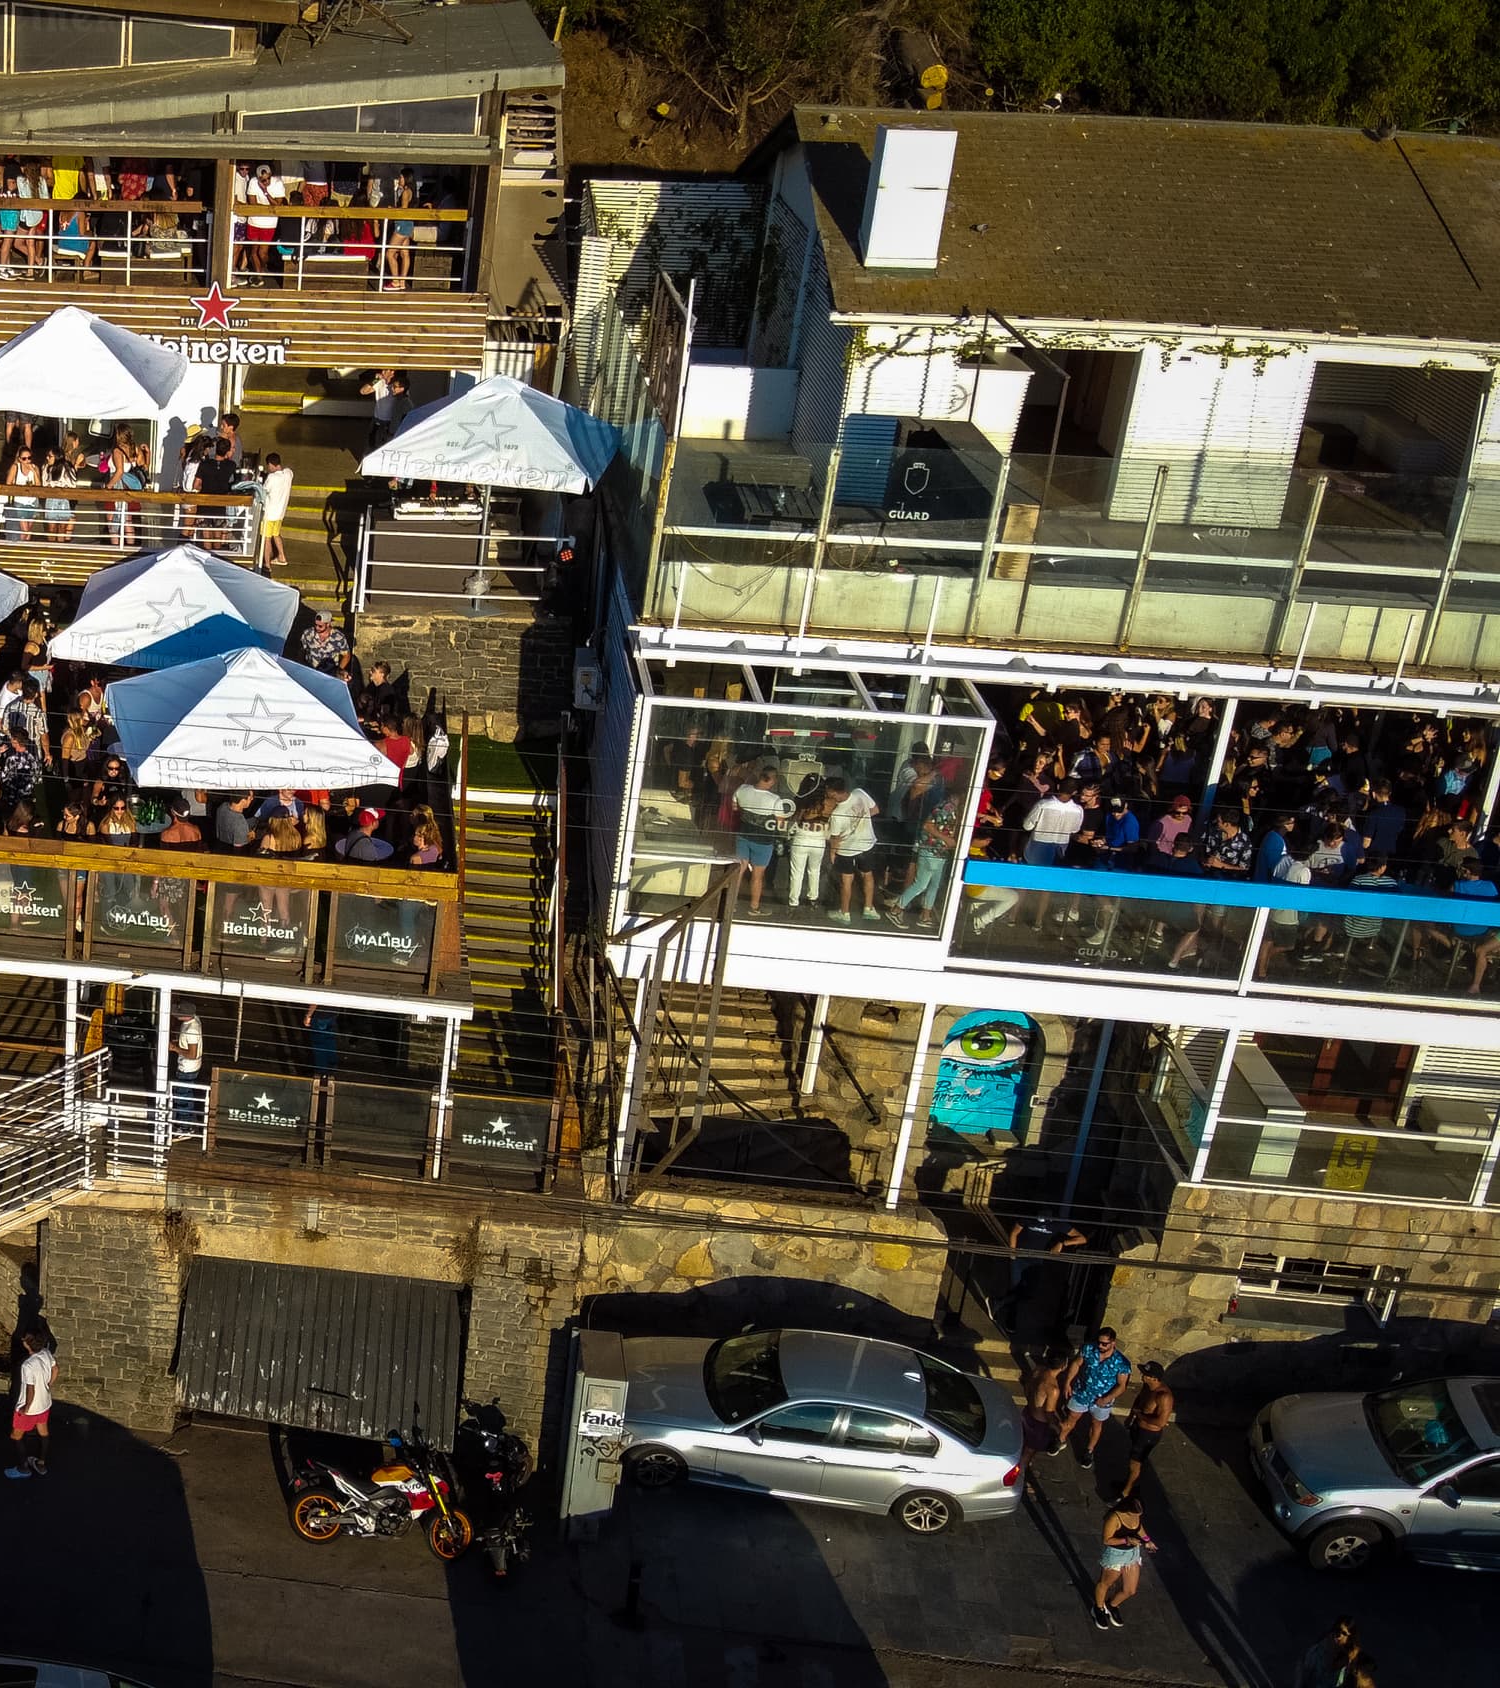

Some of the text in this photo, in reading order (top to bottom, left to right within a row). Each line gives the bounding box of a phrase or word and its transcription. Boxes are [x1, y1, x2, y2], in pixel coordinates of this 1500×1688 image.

[381, 449, 570, 490] Heineken
[888, 509, 930, 521] GUARD
[1208, 527, 1251, 538] GUARD
[156, 757, 378, 788] Heineken
[114, 910, 170, 928] MALIBÚ
[222, 921, 295, 940] Heineken
[354, 931, 412, 949] MALIBÚ
[1077, 947, 1118, 958] GUARD
[228, 1108, 297, 1128] Heineken
[462, 1133, 535, 1151] Heineken
